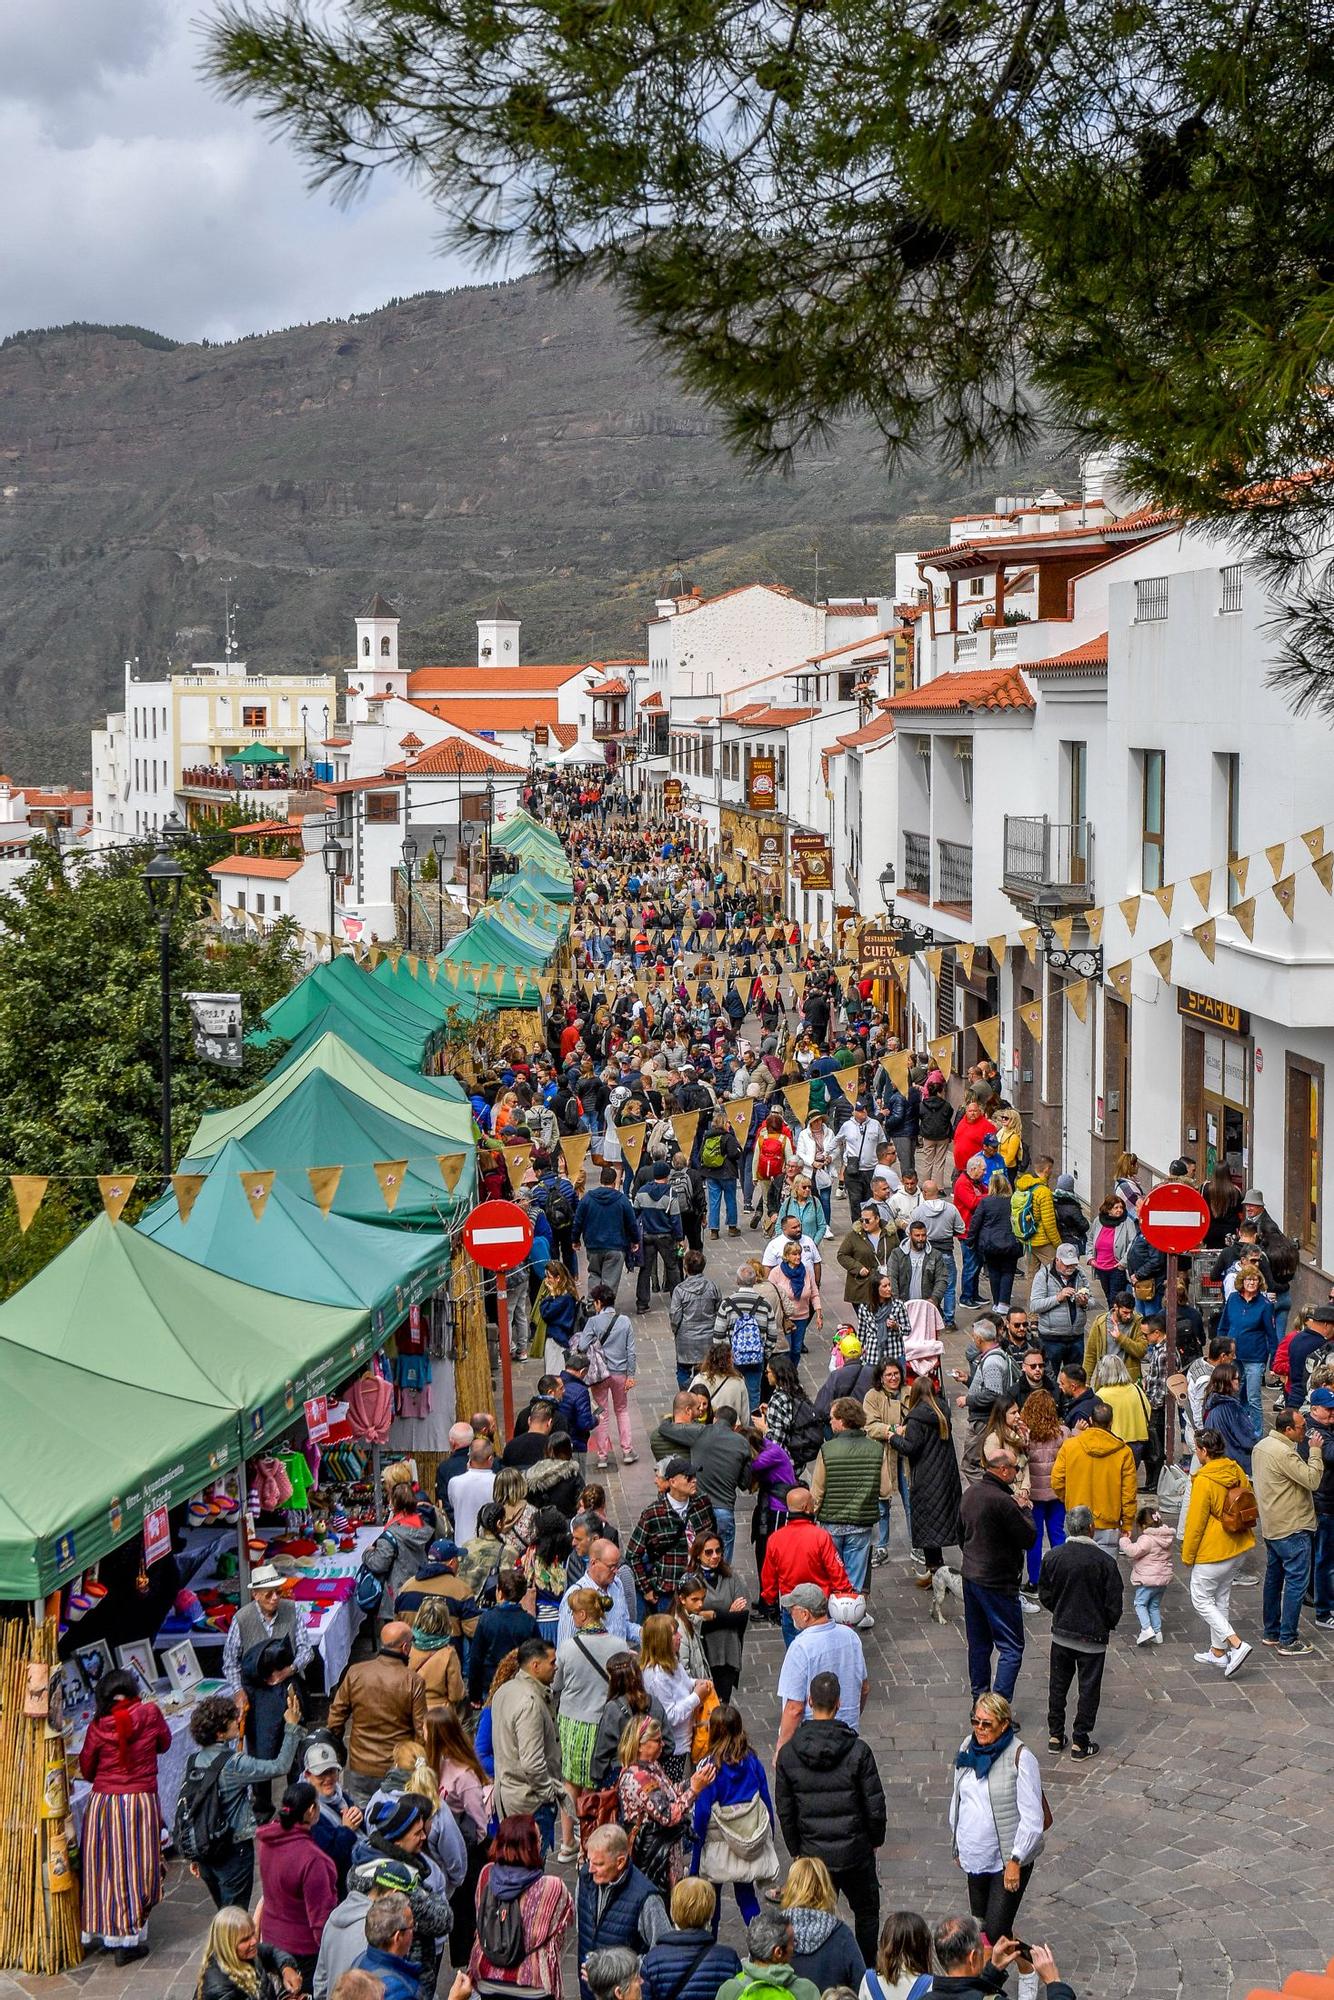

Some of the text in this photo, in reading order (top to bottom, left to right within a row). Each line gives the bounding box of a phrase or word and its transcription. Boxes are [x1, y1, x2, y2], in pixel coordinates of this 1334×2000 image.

[863, 945, 900, 957] CUEVA
[1188, 990, 1223, 1018] SPAR
[143, 1464, 185, 1498] Ayuntamiento
[152, 1489, 172, 1510] Tejeda
